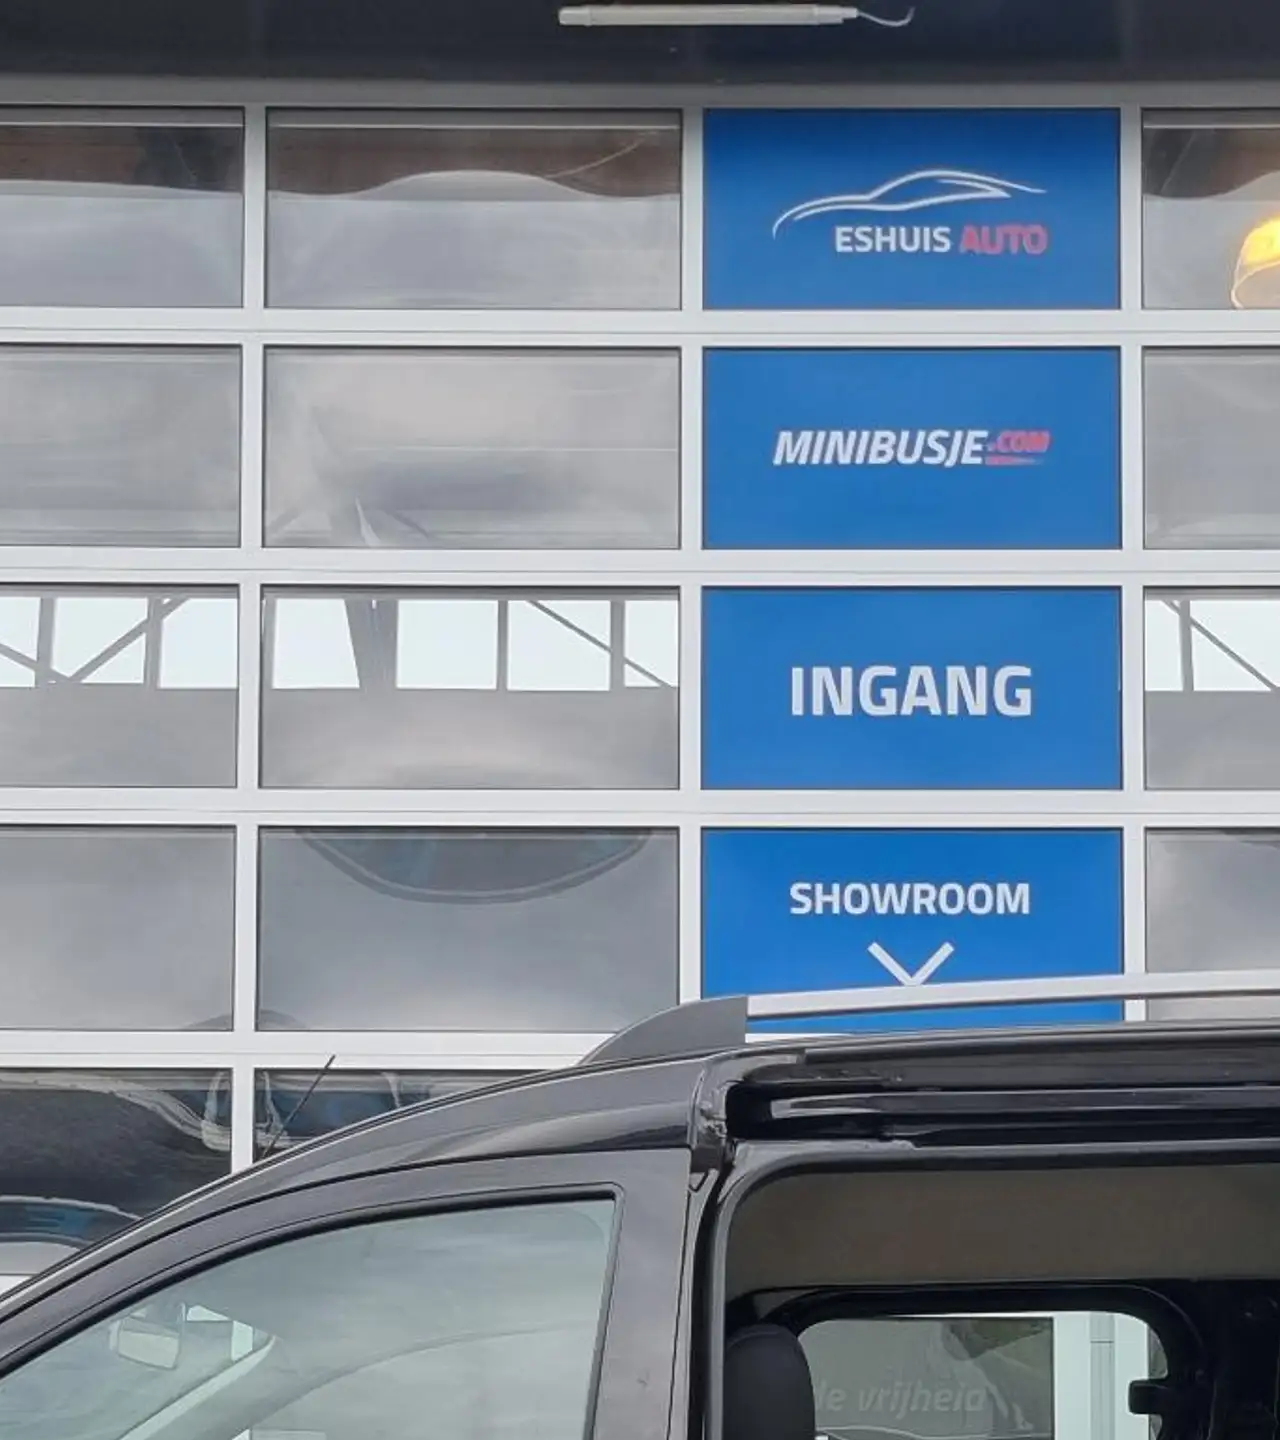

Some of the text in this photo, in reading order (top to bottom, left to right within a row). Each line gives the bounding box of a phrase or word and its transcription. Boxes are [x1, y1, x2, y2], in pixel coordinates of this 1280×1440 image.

[835, 224, 1049, 255] ESHUIS AUTO
[790, 664, 1033, 717] INGANG
[789, 881, 1031, 915] SHOWROOM
